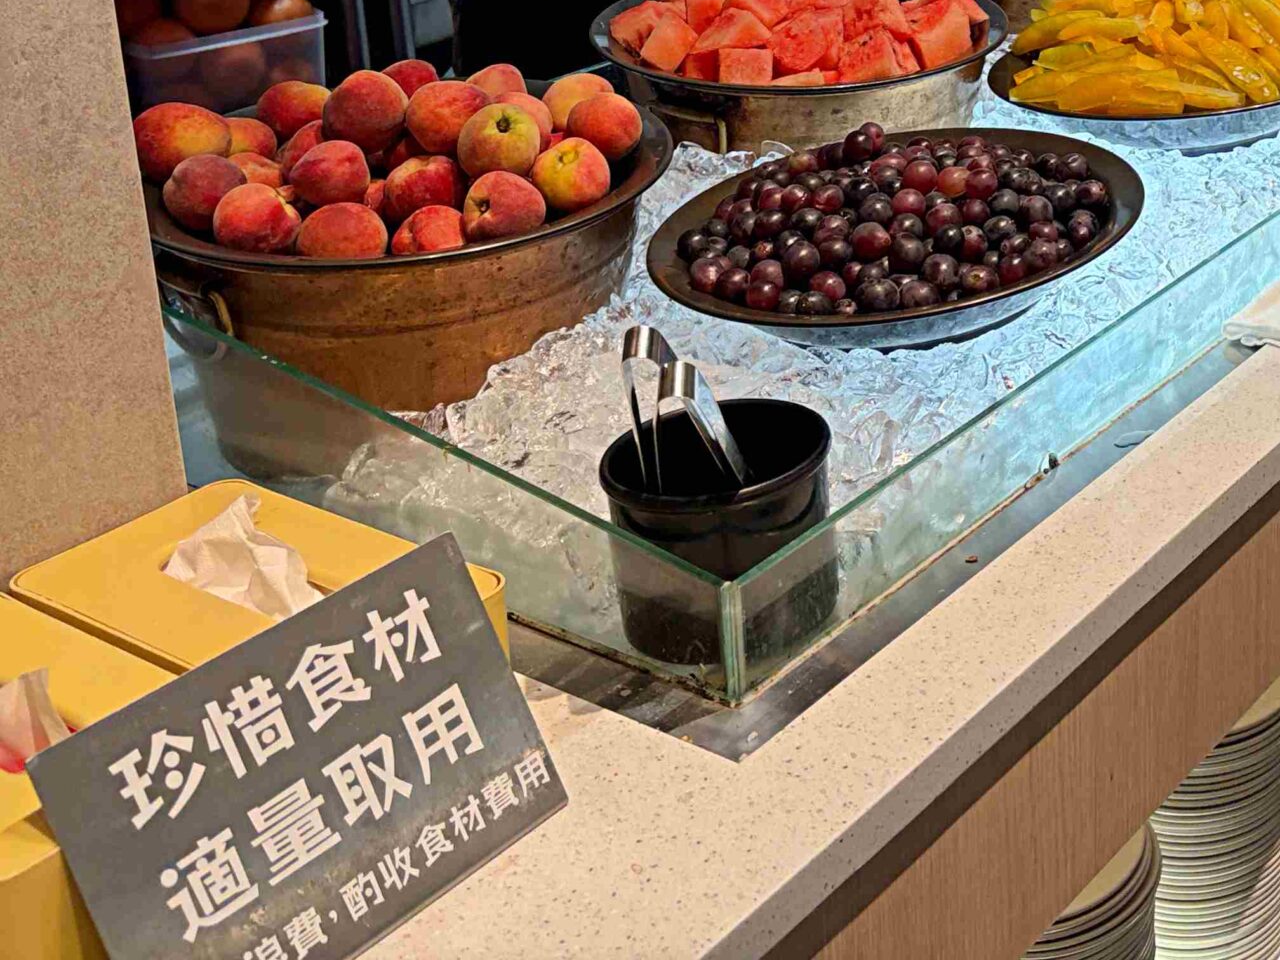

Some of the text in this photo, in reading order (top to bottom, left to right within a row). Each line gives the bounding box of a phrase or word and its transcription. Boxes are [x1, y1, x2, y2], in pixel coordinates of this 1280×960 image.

[108, 588, 443, 830] 珍惜食材
[160, 683, 485, 942] 適量取用
